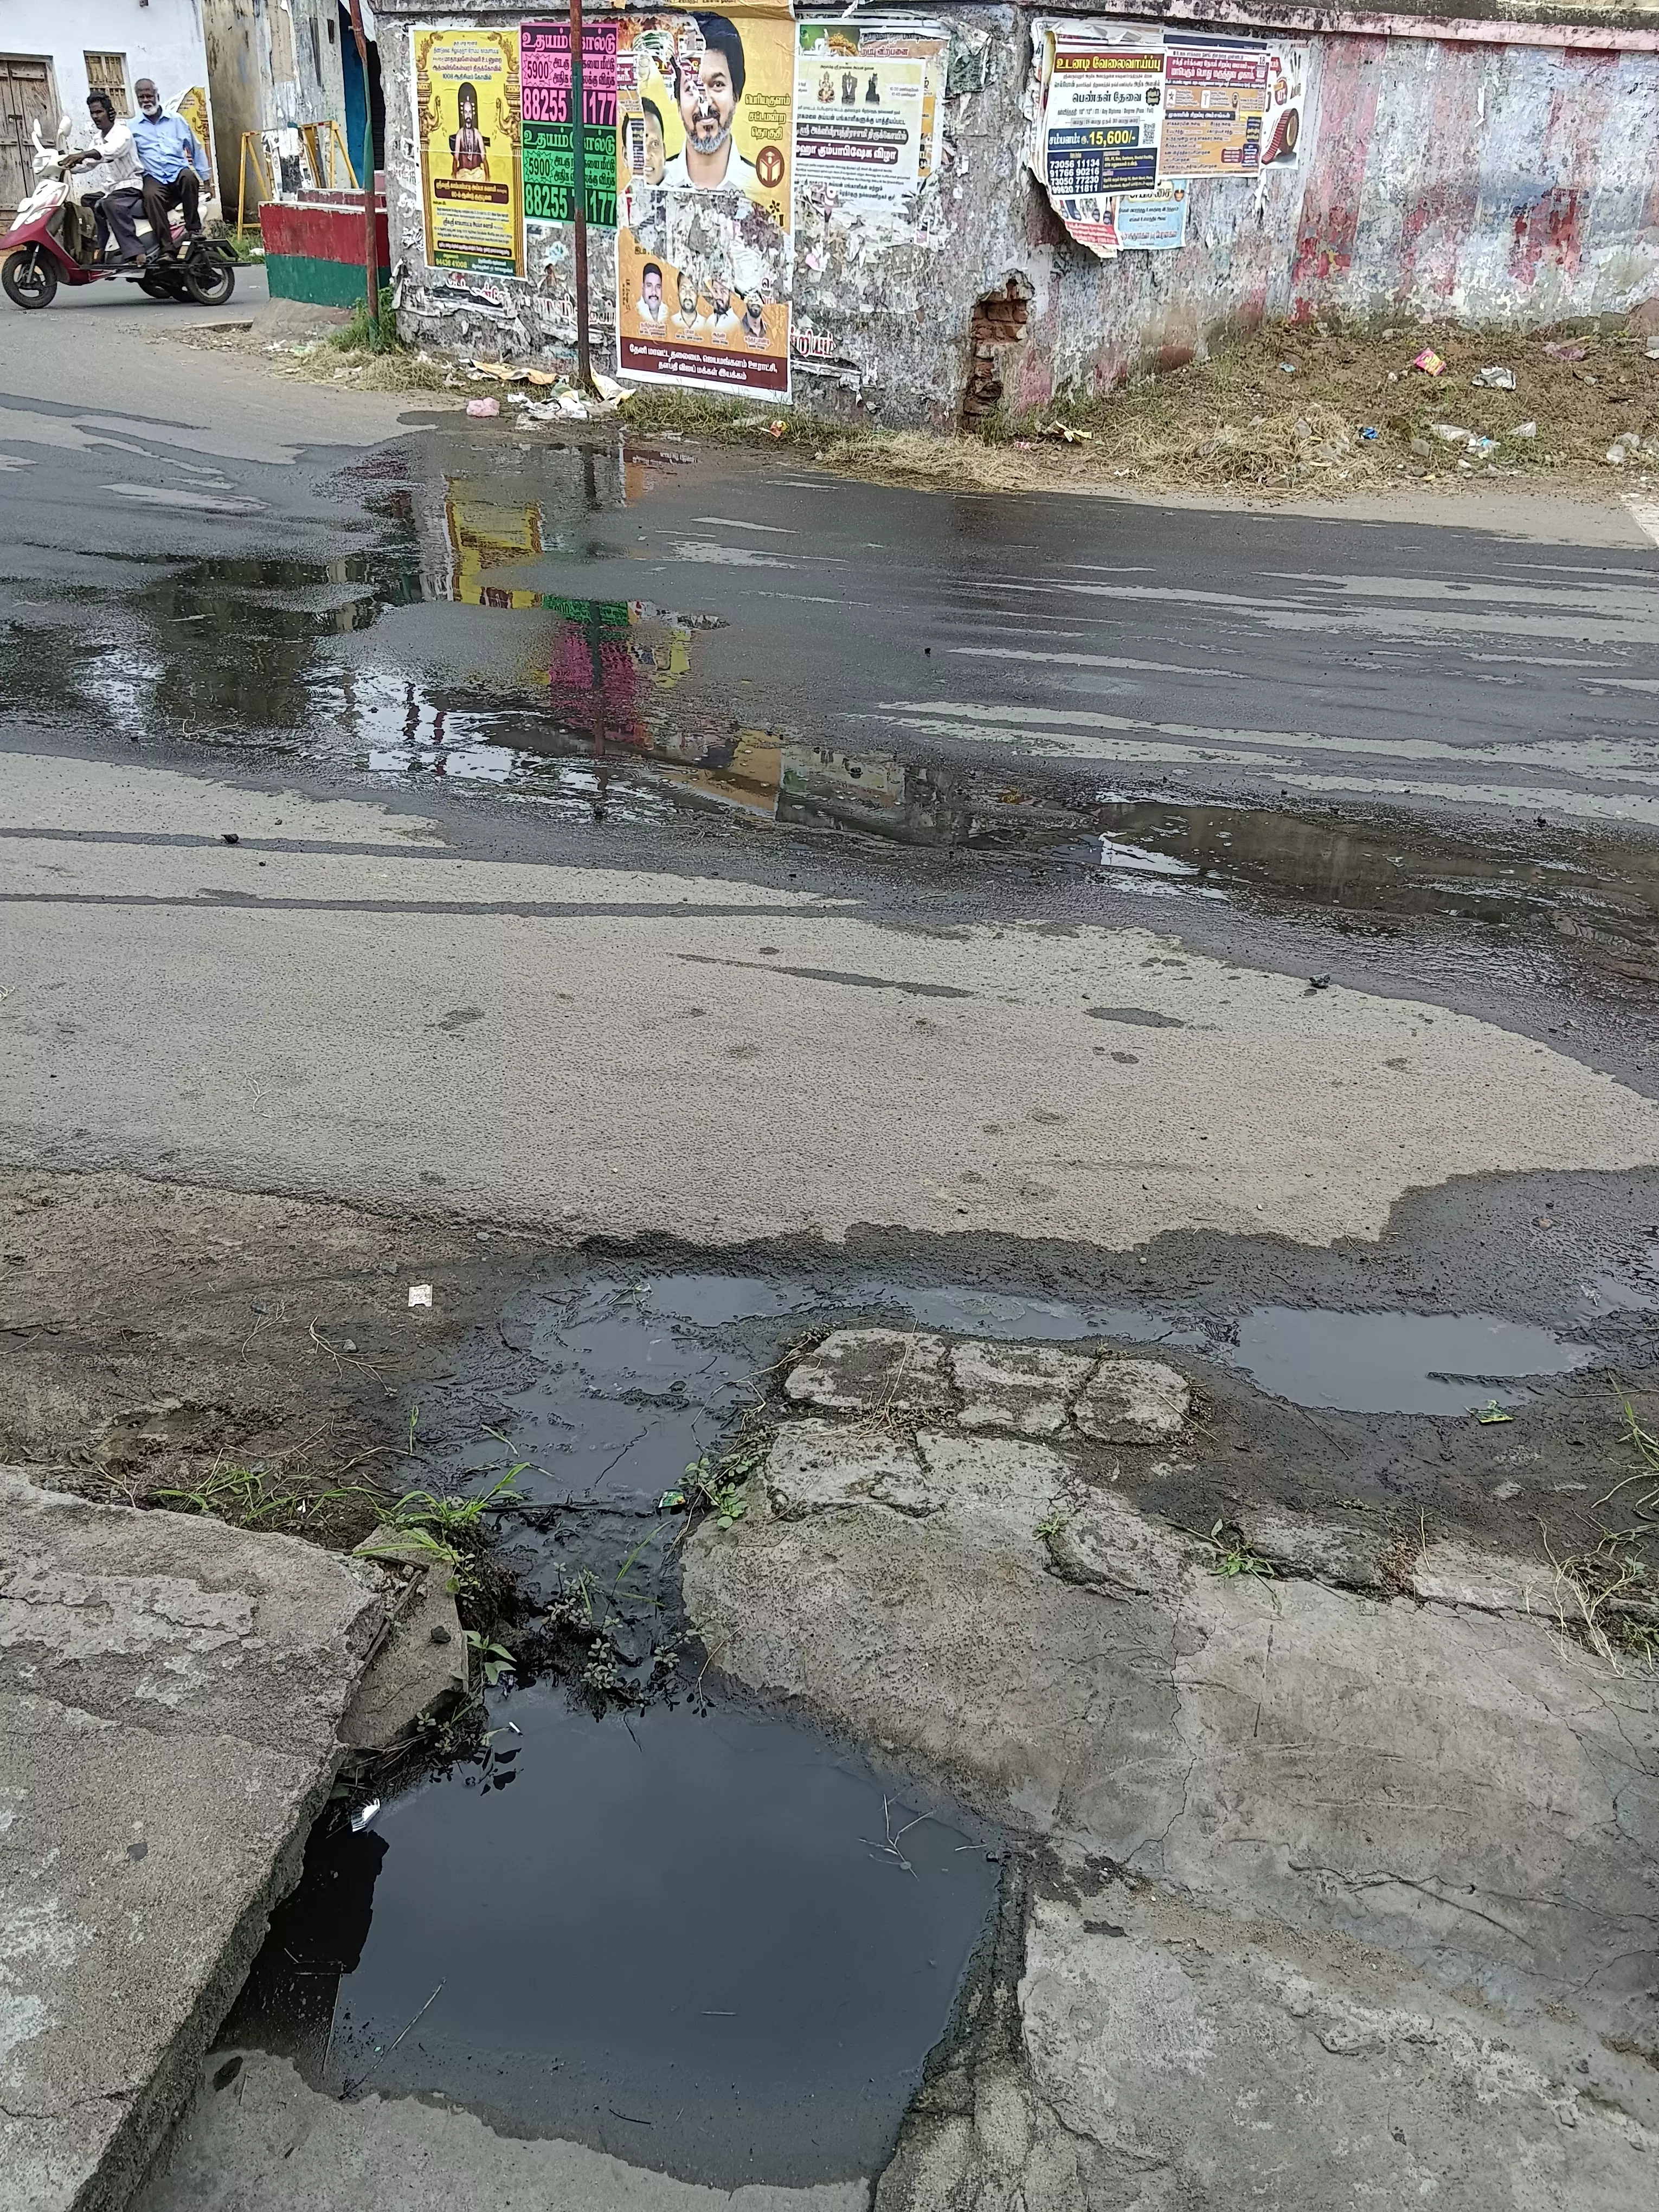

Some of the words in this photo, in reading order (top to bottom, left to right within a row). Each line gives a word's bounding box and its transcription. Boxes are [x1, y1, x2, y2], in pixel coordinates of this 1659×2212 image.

[522, 27, 568, 52] உதயம்
[877, 47, 908, 57] விற்பனை
[1259, 56, 1265, 65] 18
[527, 61, 549, 79] 5900
[553, 57, 569, 71] அடகு
[600, 56, 615, 73] மீட்டு
[1057, 58, 1090, 72] உடனடி
[1092, 54, 1161, 72] வேலைவாய்ப்பு
[553, 71, 569, 86] அதிக
[599, 72, 615, 88] விற்க
[1171, 66, 1195, 78] மாபெரும்
[1196, 69, 1212, 80] பொது
[523, 88, 567, 123] 88255
[745, 93, 790, 106] பெரியகுளம்
[1072, 90, 1111, 102] பெண்கள்
[1114, 91, 1141, 104] தேவை
[749, 110, 786, 125] சட்டமன்ற
[524, 127, 568, 150] உதயம்
[751, 127, 783, 140] தொகுதி
[1049, 132, 1081, 145] சம்பளம்:
[1089, 130, 1136, 147] 15,600/-
[873, 146, 896, 162] விழா
[529, 157, 550, 177] 5900
[554, 156, 570, 169] அடகு
[600, 156, 615, 174] மீட்டு
[1049, 169, 1075, 177] 91766
[1076, 167, 1100, 176] 90216
[1050, 160, 1075, 169] 73056
[1077, 159, 1100, 168] 11134
[554, 169, 569, 183] அதிக
[599, 171, 615, 188] விற்க
[1050, 177, 1074, 186] 73050
[1075, 176, 1099, 185] 77230
[1052, 185, 1073, 194] 99620
[1075, 184, 1098, 193] 71811
[525, 184, 568, 219] 88255
[629, 344, 647, 356] தேனி
[648, 345, 670, 358] மாவட்ட
[668, 350, 702, 363] தலைமை,
[702, 354, 747, 369] ஜெயமங்களம்
[748, 360, 777, 374] ஊராட்சி,
[658, 361, 678, 372] தளபதி
[678, 362, 696, 374] விஜய்
[697, 365, 717, 377] மக்கள்
[718, 368, 747, 380] இயக்கம்
